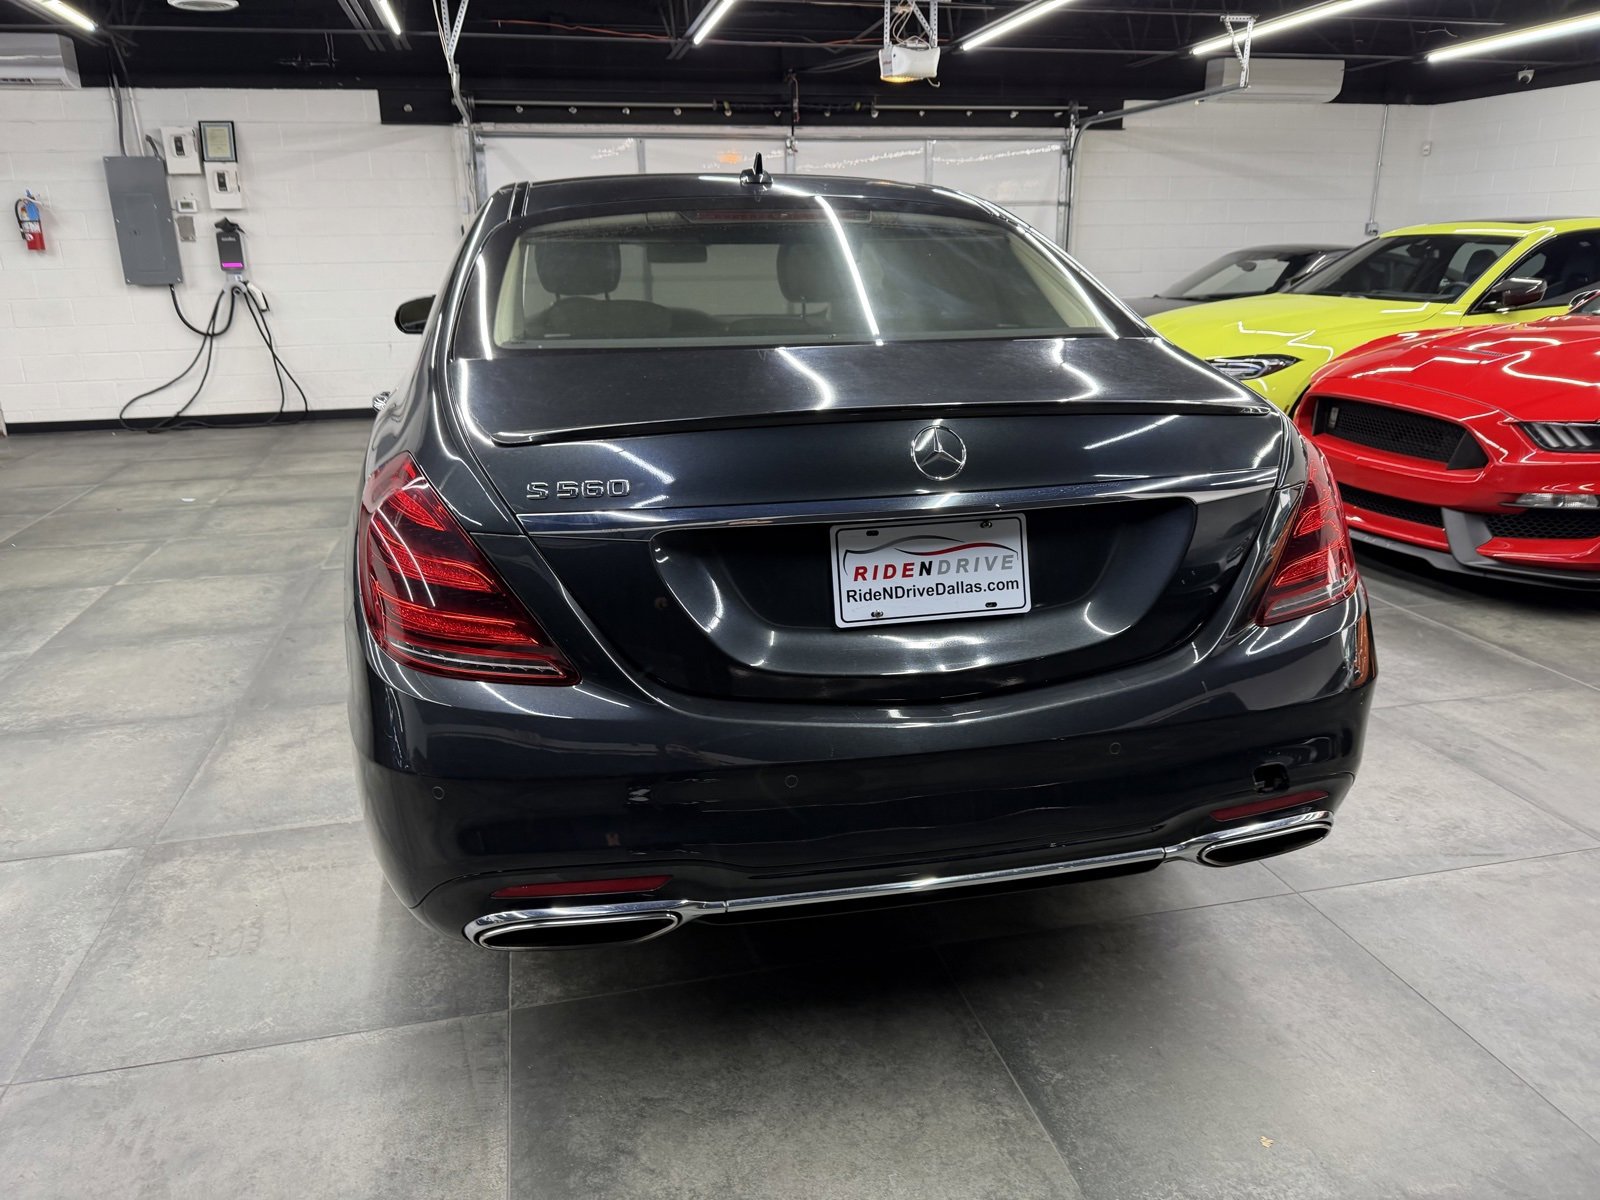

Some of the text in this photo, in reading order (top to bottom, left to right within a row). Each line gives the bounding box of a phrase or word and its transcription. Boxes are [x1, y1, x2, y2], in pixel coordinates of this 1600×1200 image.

[526, 479, 630, 500] S 560
[853, 554, 1014, 582] RIDENDRIVE
[846, 579, 1019, 603] RideNDriveDallas.com
